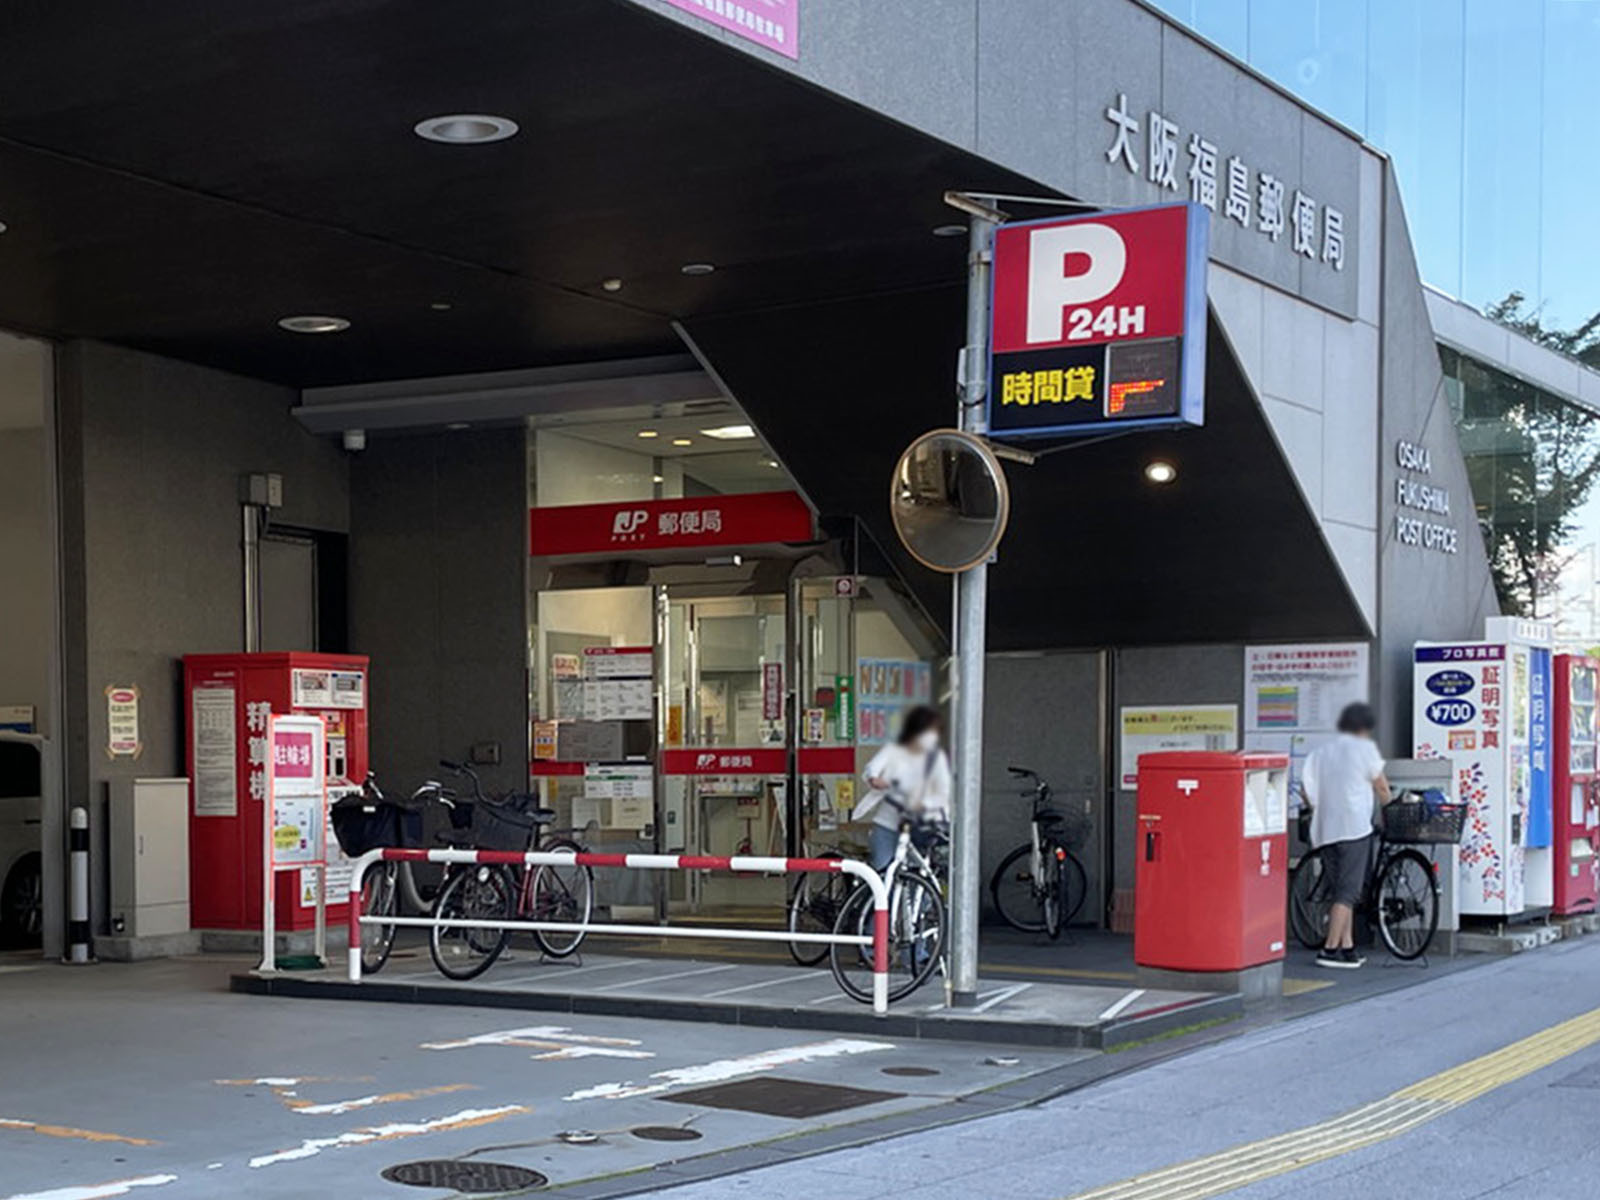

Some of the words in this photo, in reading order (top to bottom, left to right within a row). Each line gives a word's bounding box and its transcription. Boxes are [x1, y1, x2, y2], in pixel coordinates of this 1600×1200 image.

[1106, 93, 1344, 271] 大阪福島郵便局
[1026, 223, 1127, 344] P
[1067, 305, 1146, 340] 24H
[1002, 366, 1095, 405] 時間貸
[1398, 440, 1431, 474] OSAKA
[1398, 479, 1450, 515] FUKUSHIMA
[658, 509, 722, 535] 郵便局
[1397, 516, 1422, 546] POST
[1425, 523, 1458, 554] OFFICE
[1432, 703, 1471, 722] ¥700
[1481, 666, 1501, 750] 証明写真
[719, 755, 753, 768] 郵便局
